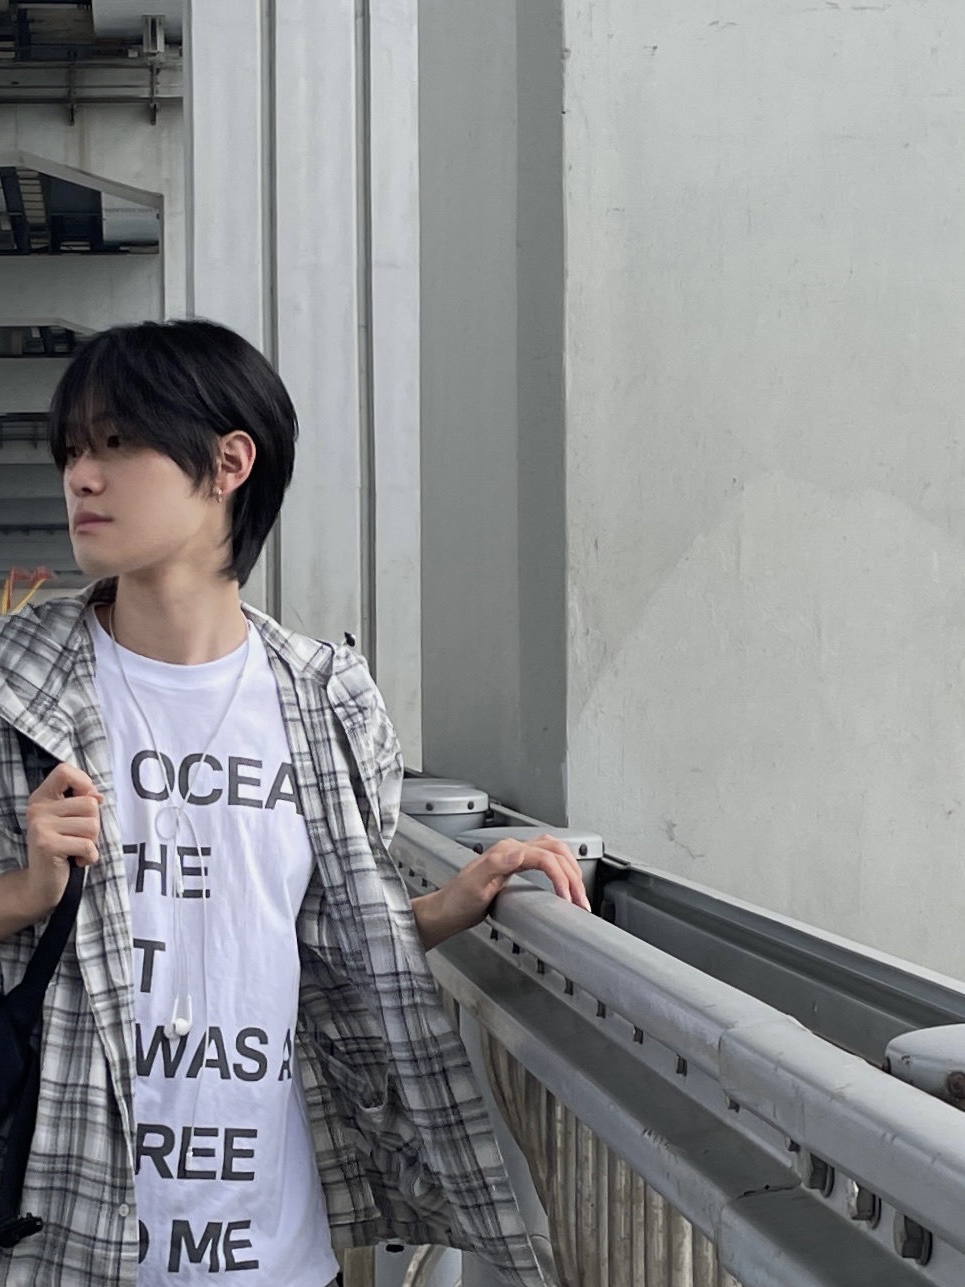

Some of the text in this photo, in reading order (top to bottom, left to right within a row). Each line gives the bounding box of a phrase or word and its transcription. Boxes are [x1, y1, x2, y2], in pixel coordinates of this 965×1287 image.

[130, 749, 304, 816] OCEA
[135, 1022, 269, 1082] WAS
[135, 1122, 258, 1182] REE
[167, 1218, 260, 1274] ME
